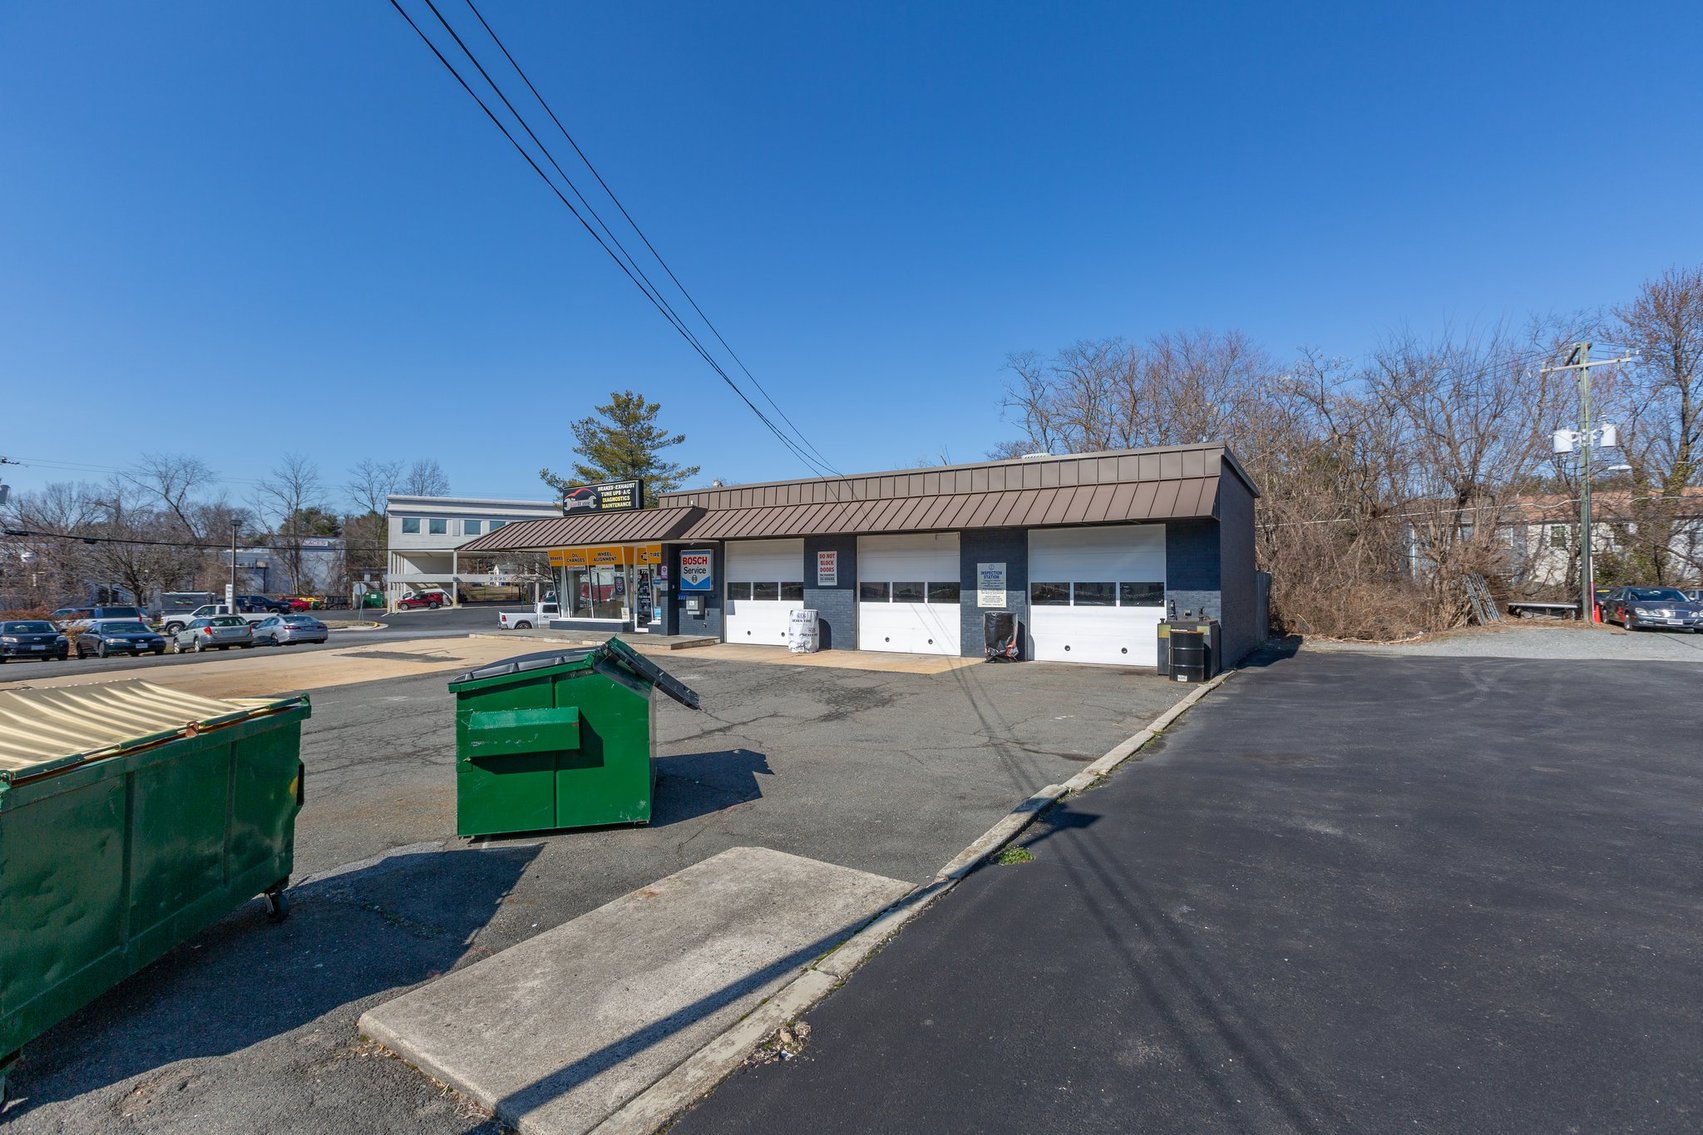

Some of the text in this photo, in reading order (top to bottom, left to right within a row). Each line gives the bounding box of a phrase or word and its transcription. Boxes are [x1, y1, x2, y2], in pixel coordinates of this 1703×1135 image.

[602, 501, 631, 509] MAINTENANCE
[682, 556, 708, 566] BOSCH
[683, 566, 707, 575] Service
